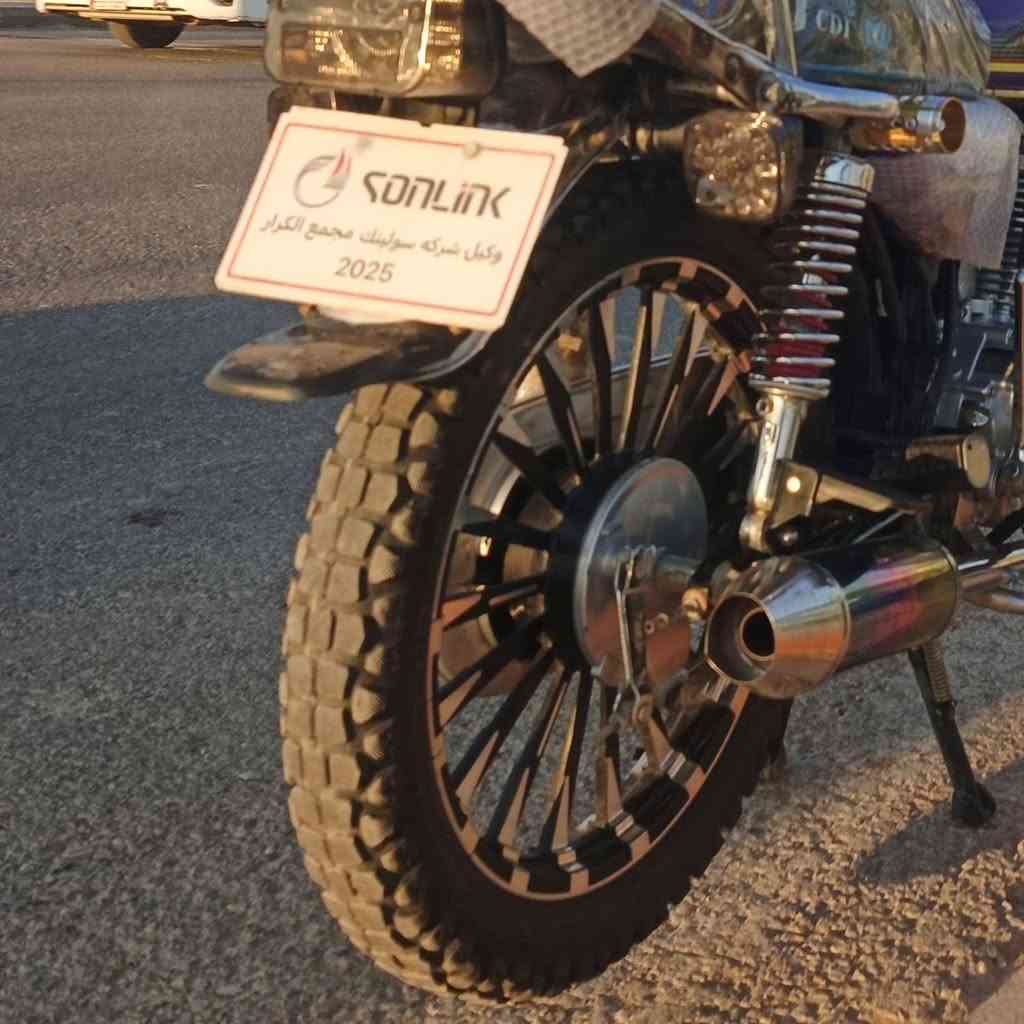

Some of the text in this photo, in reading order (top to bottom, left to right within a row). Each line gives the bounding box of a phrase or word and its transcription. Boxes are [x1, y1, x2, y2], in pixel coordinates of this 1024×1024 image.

[304, 221, 354, 241] مجمع
[464, 241, 503, 266] وكيل
[334, 256, 394, 284] 2025
